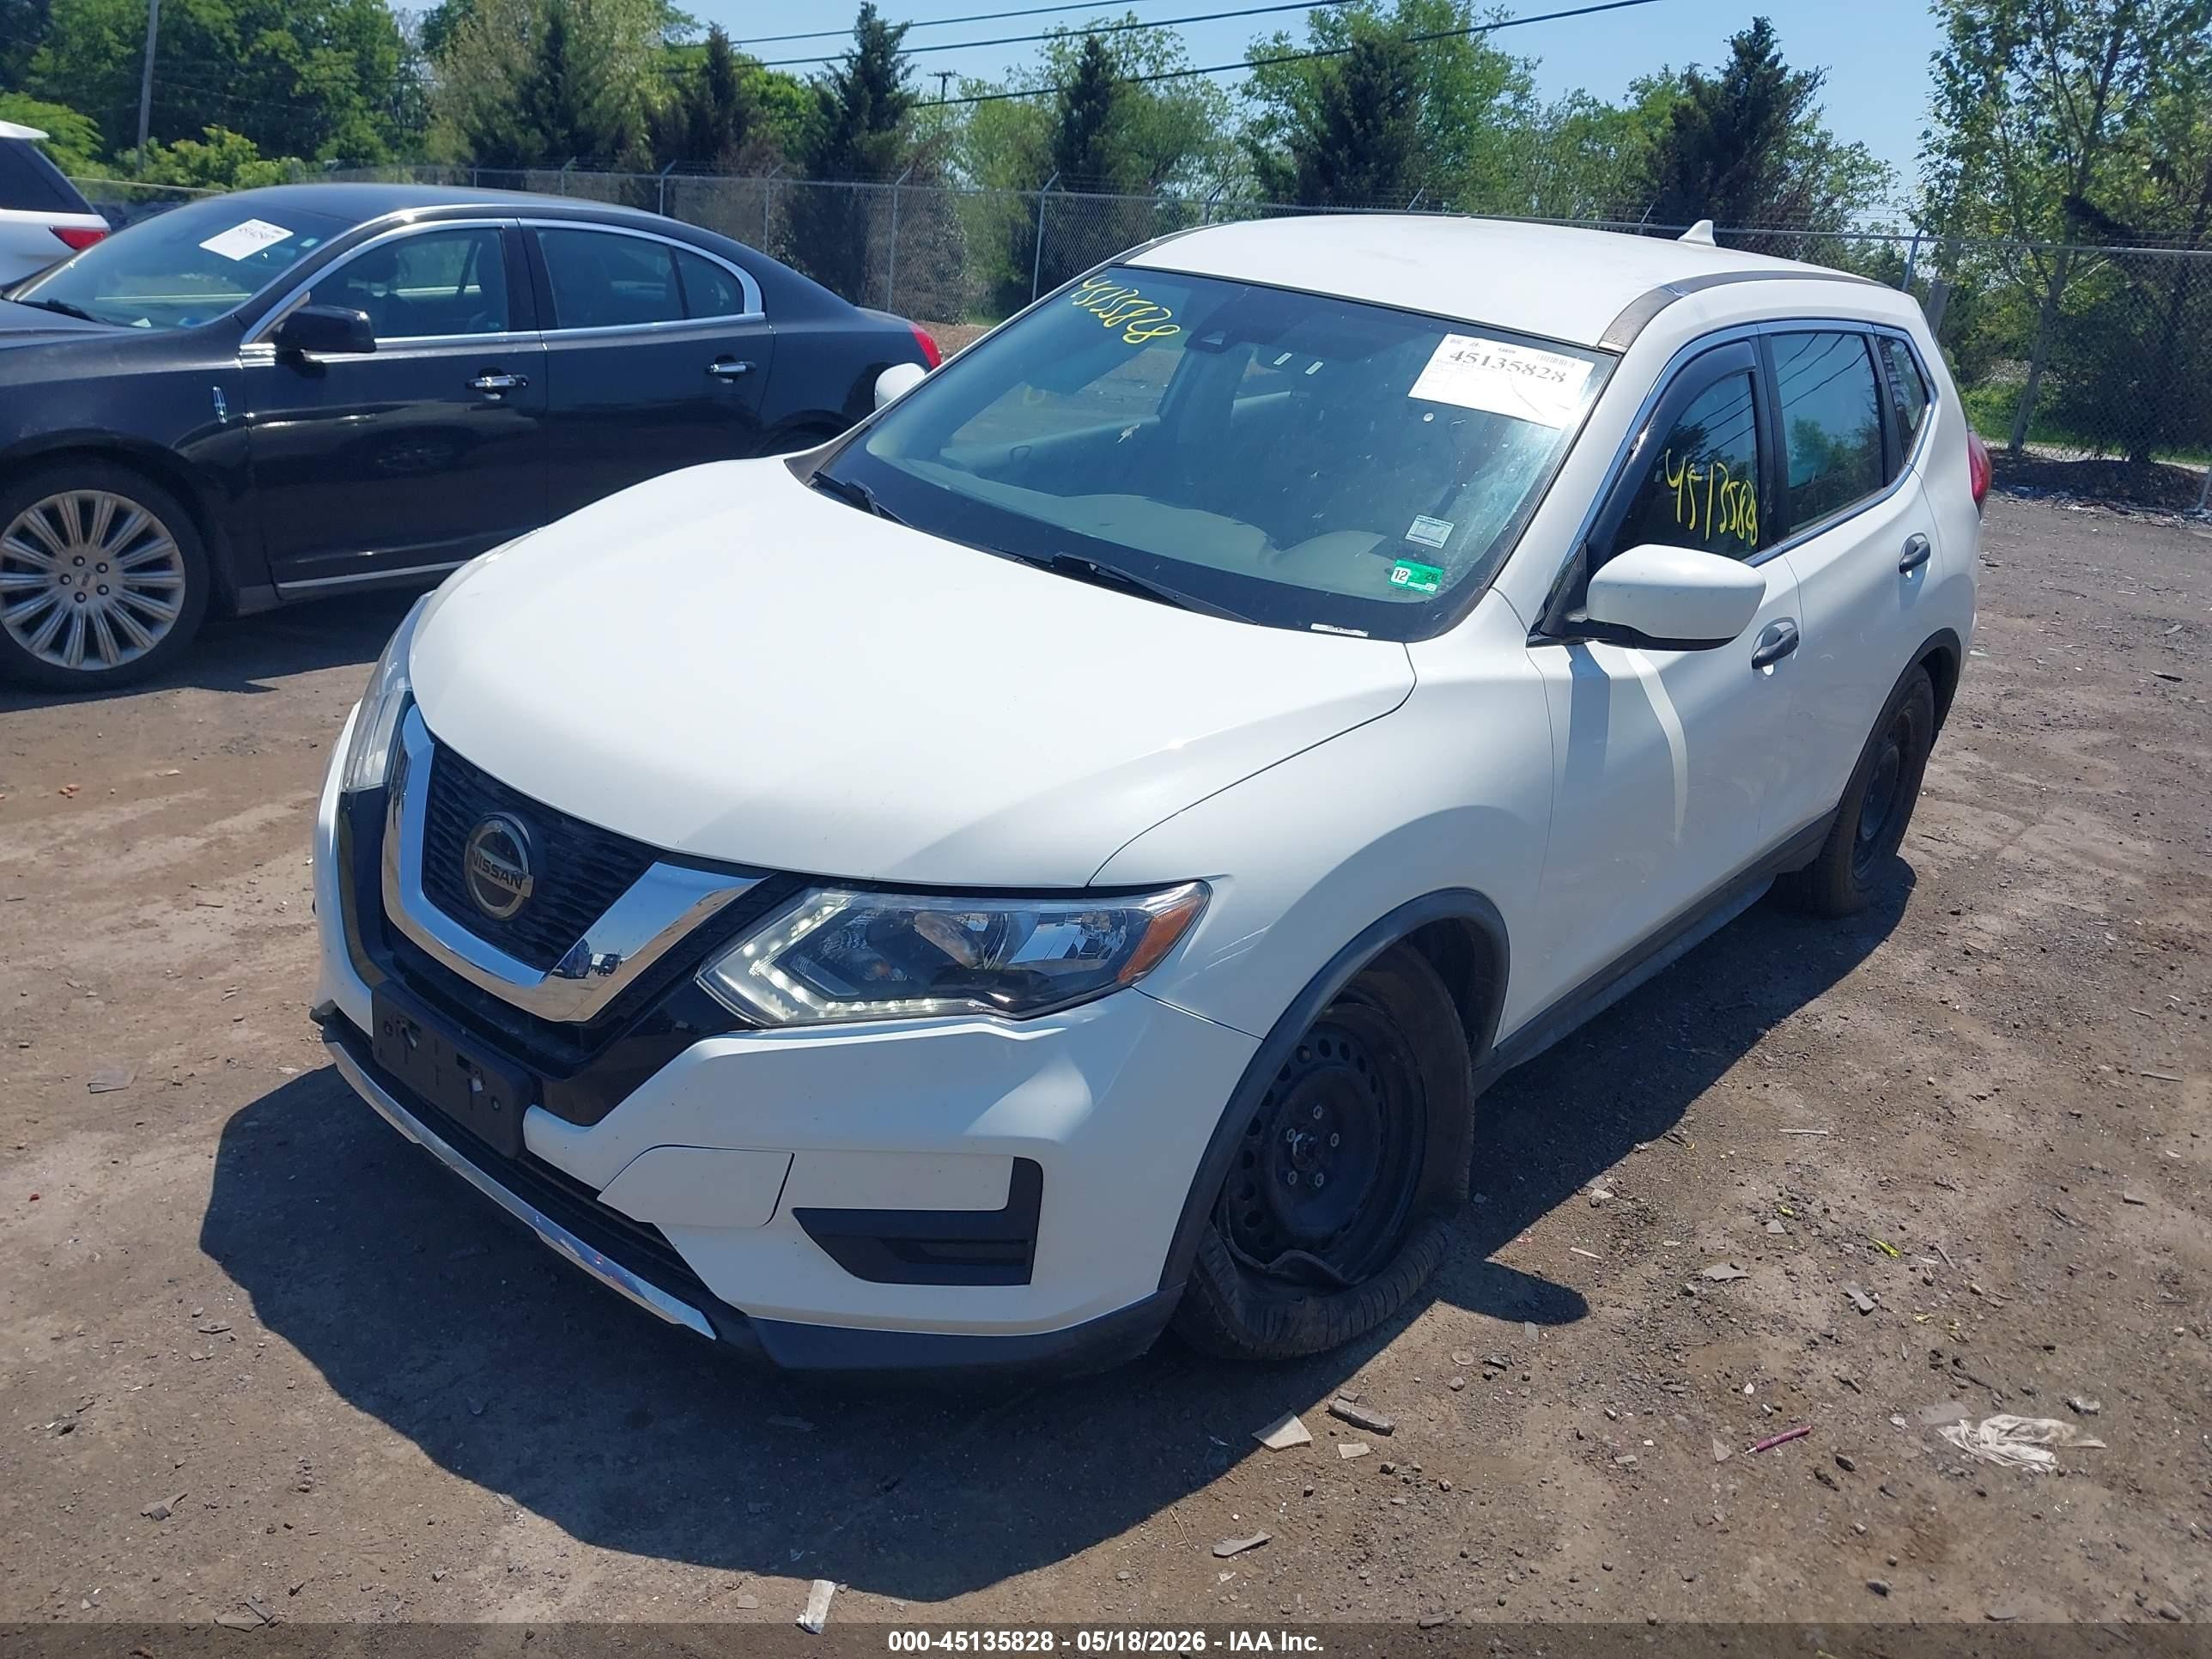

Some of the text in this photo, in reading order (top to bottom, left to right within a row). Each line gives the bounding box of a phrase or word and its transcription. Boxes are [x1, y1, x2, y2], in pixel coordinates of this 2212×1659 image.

[1449, 350, 1567, 383] 45135828
[1395, 568, 1408, 581] 12
[474, 851, 523, 890] NISSAN
